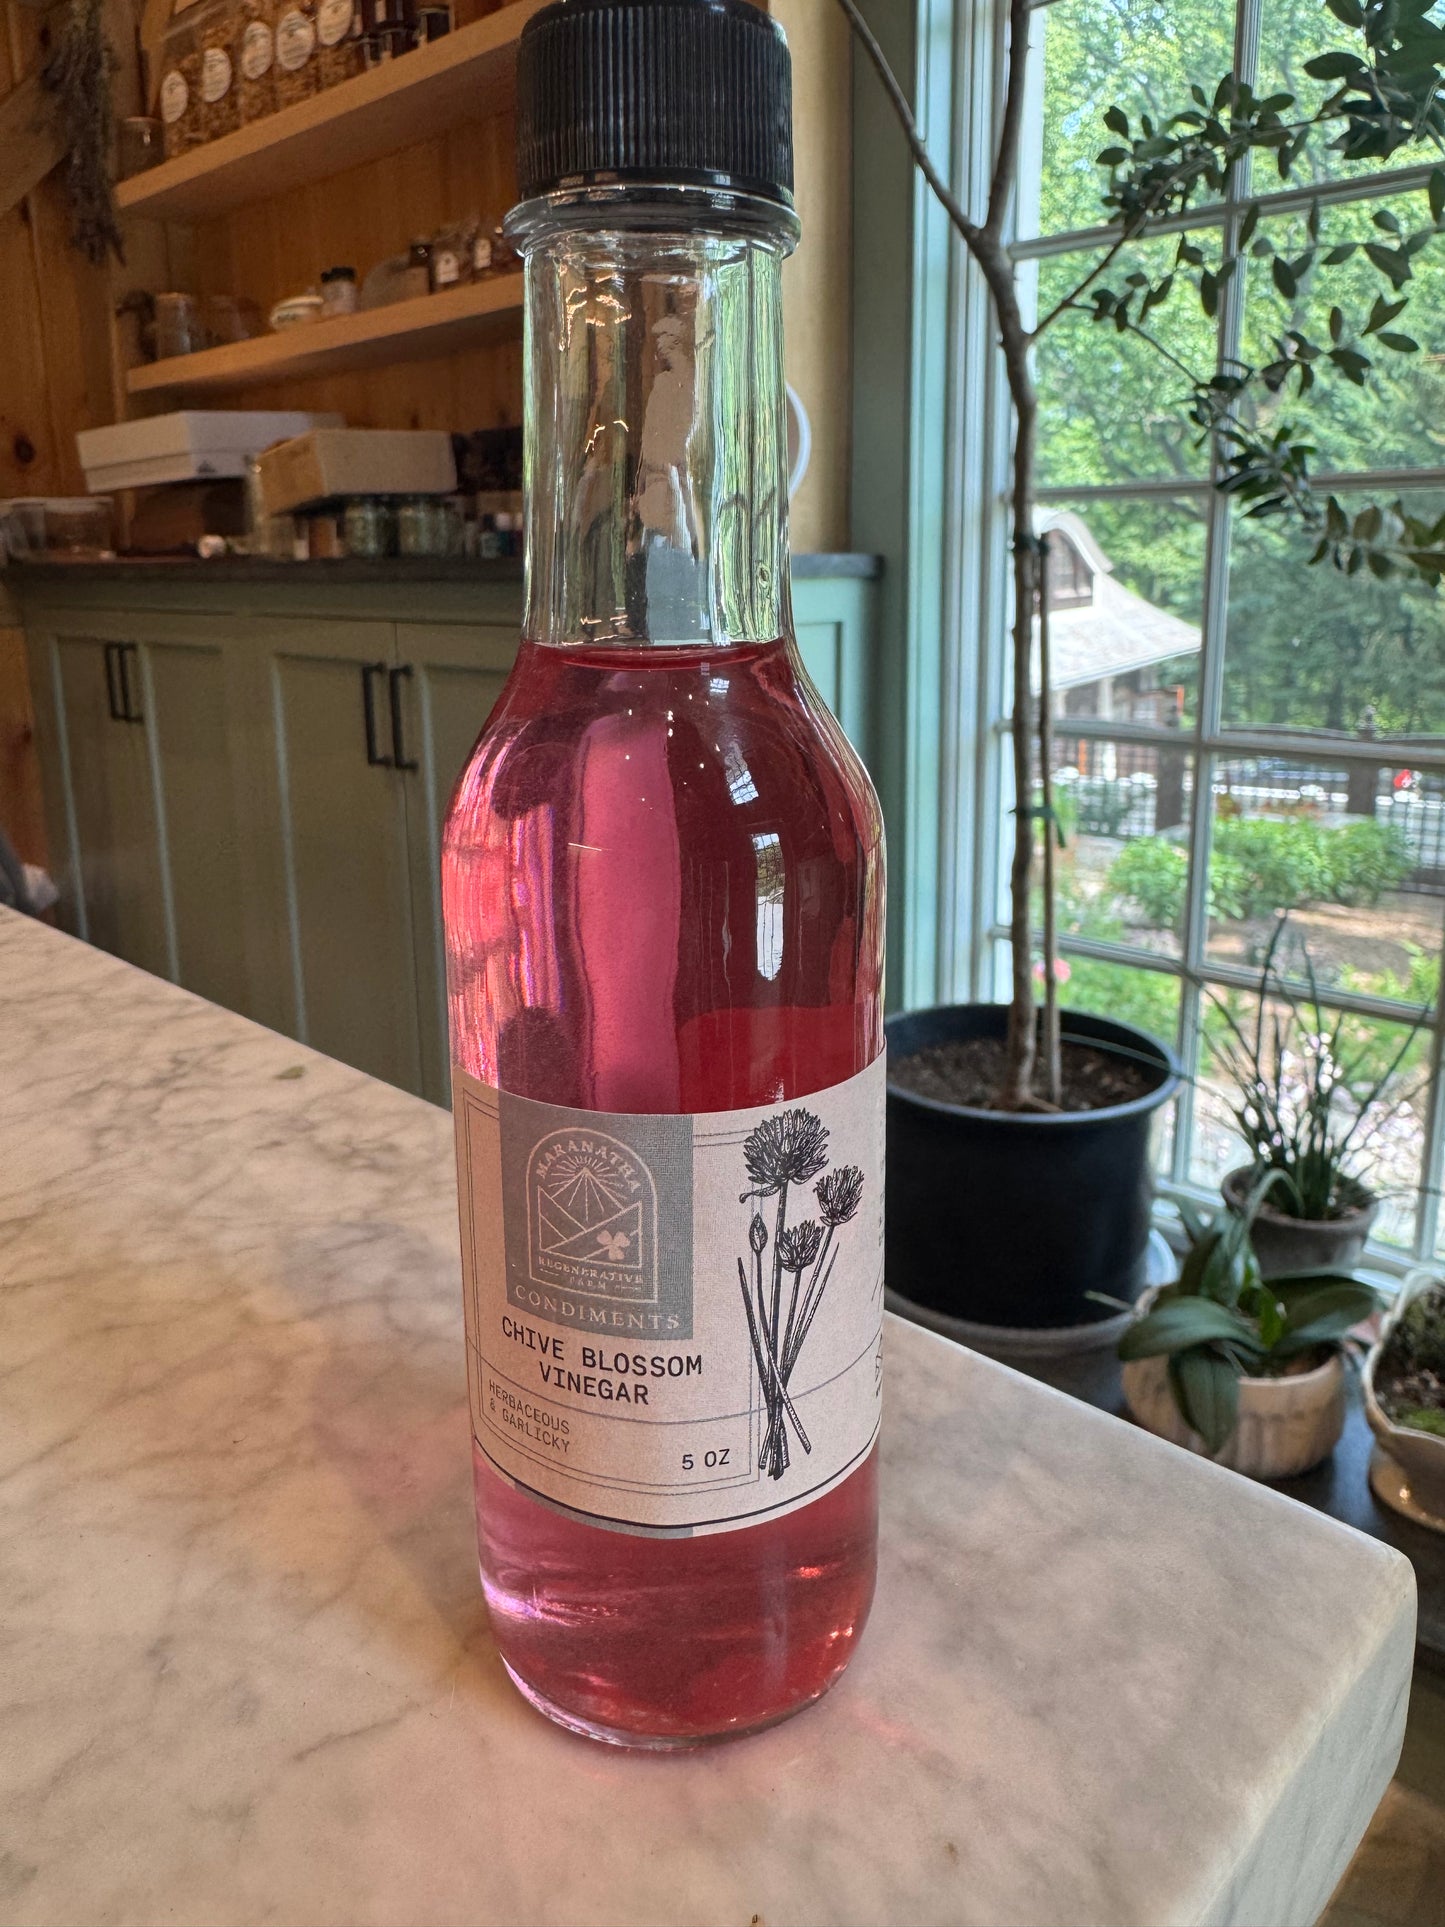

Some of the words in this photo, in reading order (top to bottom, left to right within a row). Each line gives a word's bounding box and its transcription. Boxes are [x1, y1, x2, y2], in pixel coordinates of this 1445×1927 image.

[536, 1139, 641, 1193] MARANATHA
[515, 1285, 681, 1330] CONDIMENTS
[502, 1316, 564, 1361] CHIVE
[582, 1347, 702, 1377] BLOSSOM
[539, 1361, 649, 1405] VINEGAR
[489, 1379, 570, 1435] HERBACEOUS
[502, 1408, 570, 1453] GARLICKY
[682, 1453, 694, 1470] 5
[704, 1448, 730, 1468] OZ
